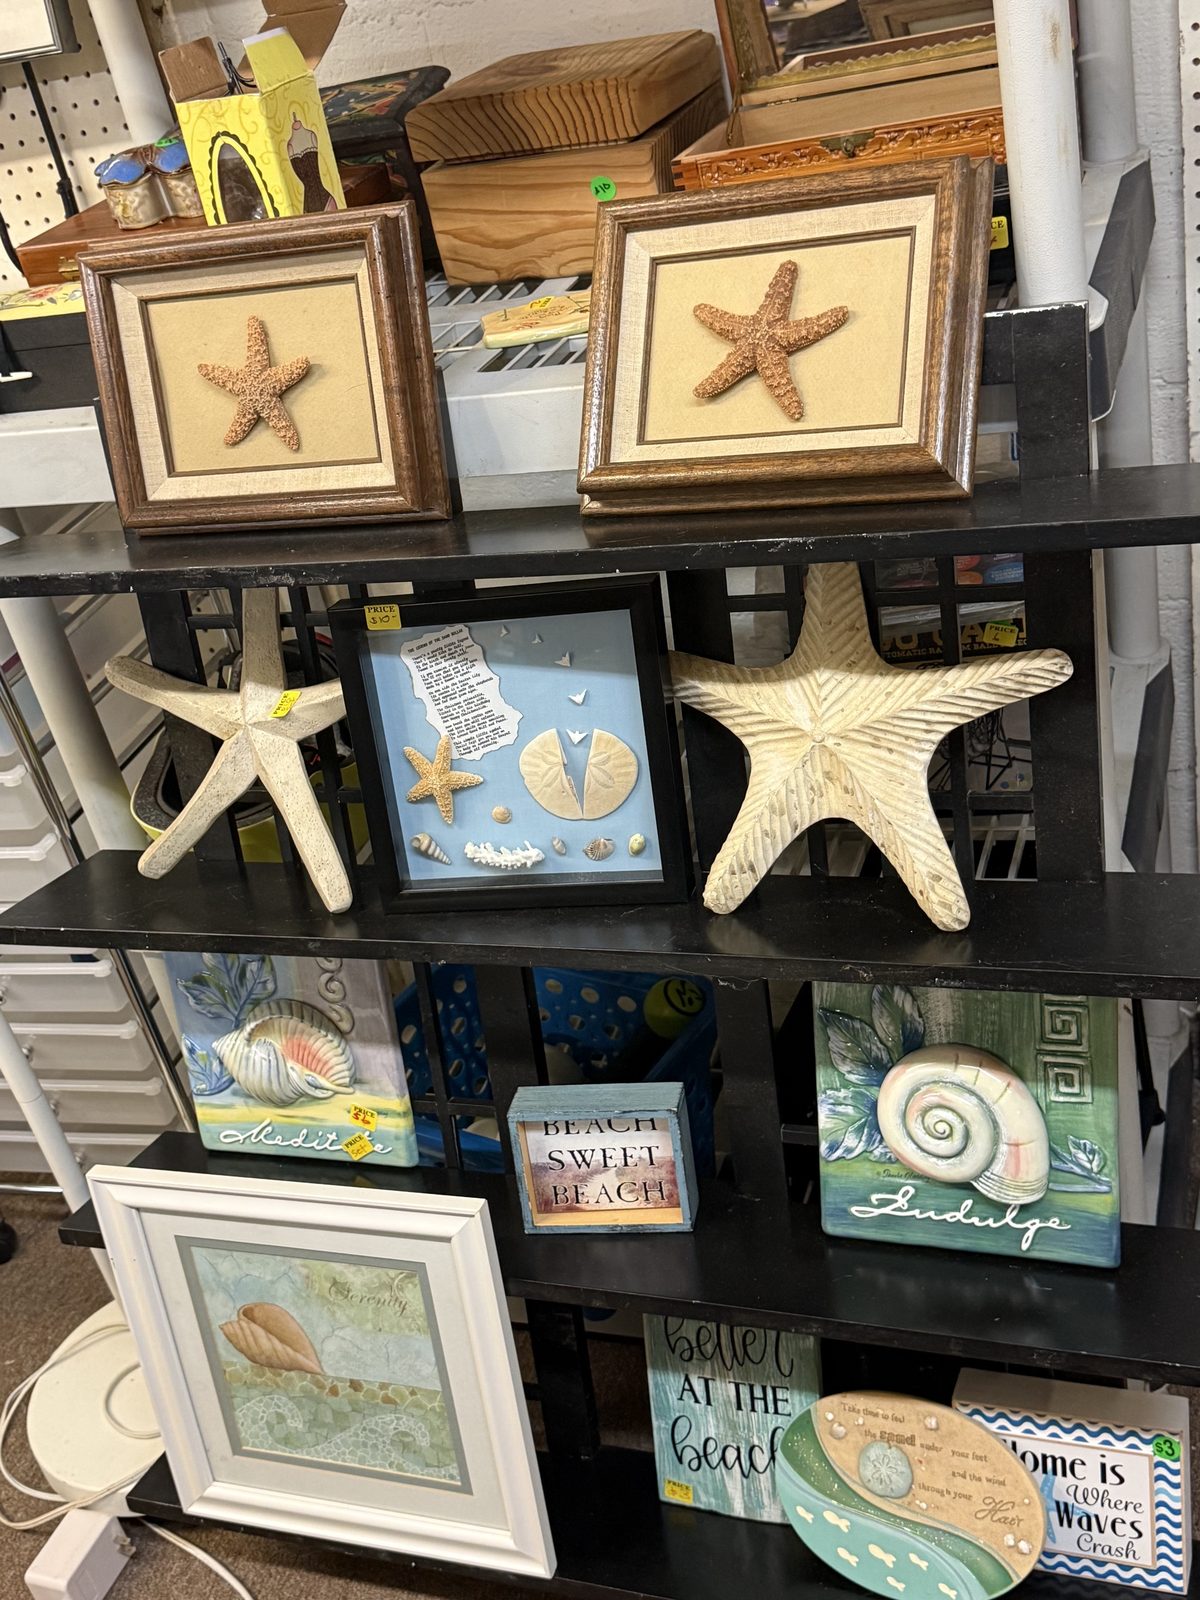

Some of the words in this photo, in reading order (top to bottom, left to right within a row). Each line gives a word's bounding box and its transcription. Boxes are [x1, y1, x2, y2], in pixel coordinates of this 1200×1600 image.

[368, 605, 396, 613] PRICE
[989, 624, 1015, 634] PRICE
[354, 1106, 376, 1119] PRICE
[219, 1118, 393, 1154] Medite
[543, 1117, 657, 1136] BEACH
[344, 1134, 364, 1149] PRICE
[548, 1145, 660, 1171] SWEET
[552, 1180, 668, 1205] BEACH
[850, 1185, 1071, 1251] Indulge
[328, 1276, 408, 1317] Serenity
[677, 1373, 717, 1407] AT
[728, 1380, 792, 1417] THE
[840, 1402, 861, 1415] Take
[862, 1407, 880, 1417] time
[864, 1428, 877, 1440] the
[879, 1430, 916, 1447] sand
[919, 1441, 944, 1453] under
[950, 1449, 970, 1461] your
[971, 1452, 988, 1463] feet
[1155, 1438, 1176, 1457] $3
[951, 1469, 967, 1481] and
[968, 1472, 983, 1483] the
[984, 1475, 1007, 1487] wind
[1099, 1454, 1126, 1487] is
[918, 1482, 952, 1498] through
[953, 1490, 974, 1502] your
[1066, 1483, 1145, 1514] Where
[1054, 1499, 1144, 1540] Waves
[1076, 1532, 1142, 1561] Crash
